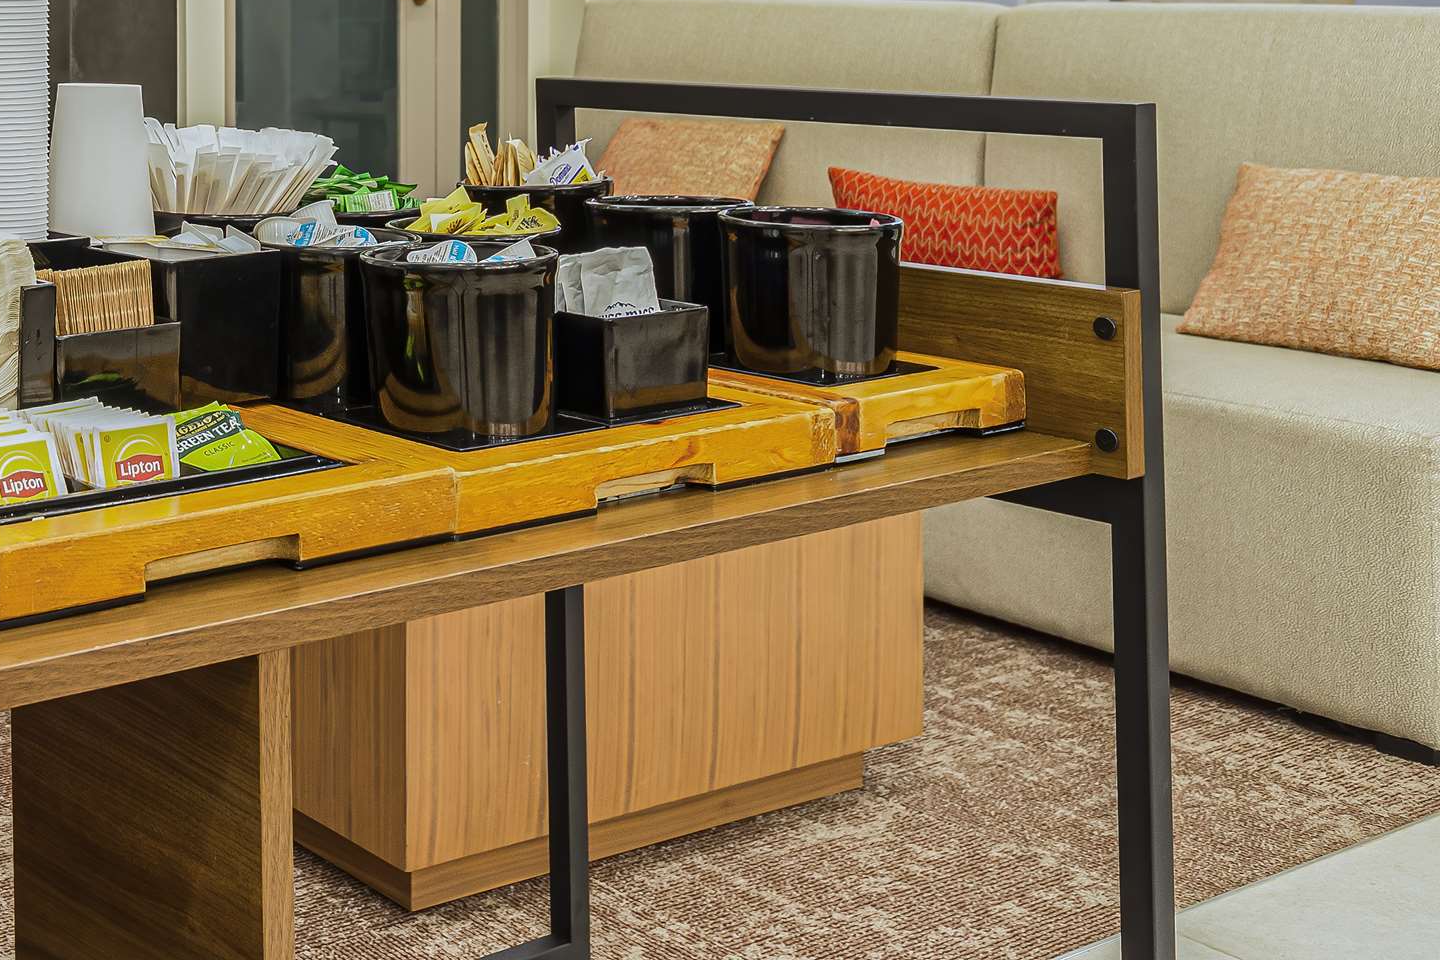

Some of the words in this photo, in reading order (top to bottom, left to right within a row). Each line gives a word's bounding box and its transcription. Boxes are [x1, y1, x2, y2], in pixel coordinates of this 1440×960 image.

[176, 429, 216, 454] GREEN
[212, 415, 241, 436] TEA
[203, 441, 236, 457] CLASSIC
[119, 459, 162, 477] Lipton
[1, 476, 45, 495] Lipton
